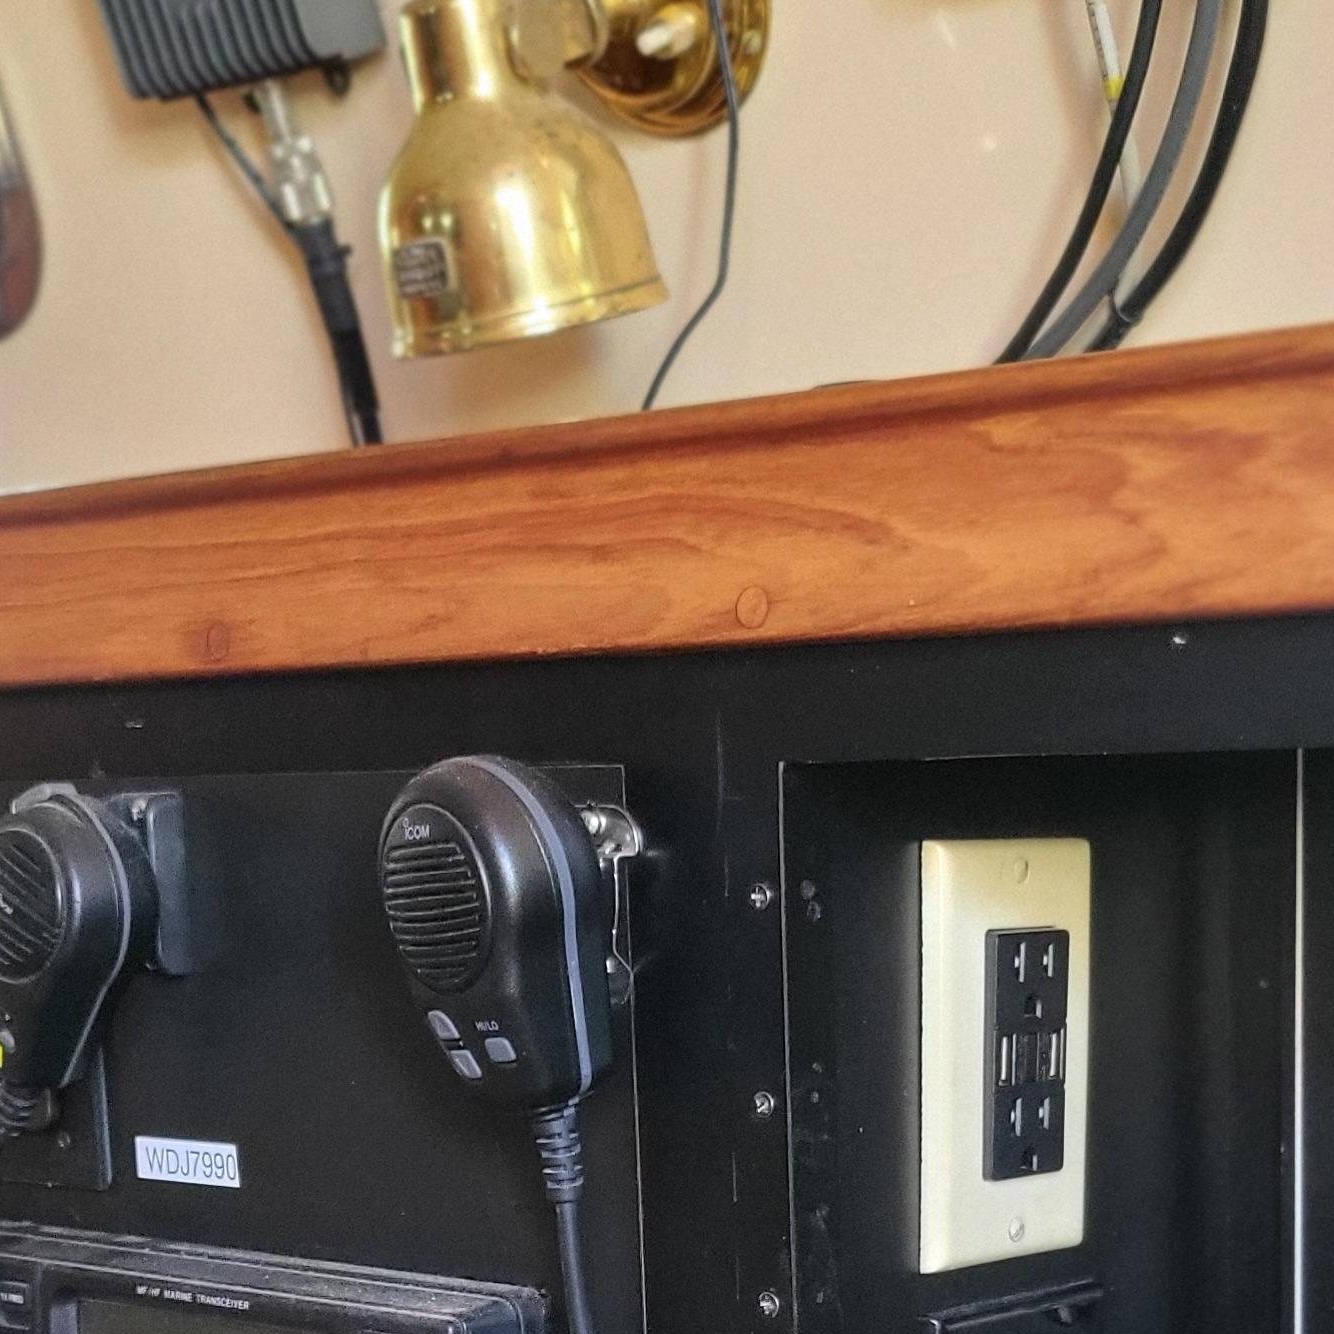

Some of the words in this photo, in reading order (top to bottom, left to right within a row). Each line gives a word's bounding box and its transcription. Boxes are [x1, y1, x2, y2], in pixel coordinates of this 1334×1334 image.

[146, 1146, 236, 1180] WDJ7990
[164, 1290, 193, 1302] MARINE
[196, 1294, 249, 1310] TRANSCEIVER
